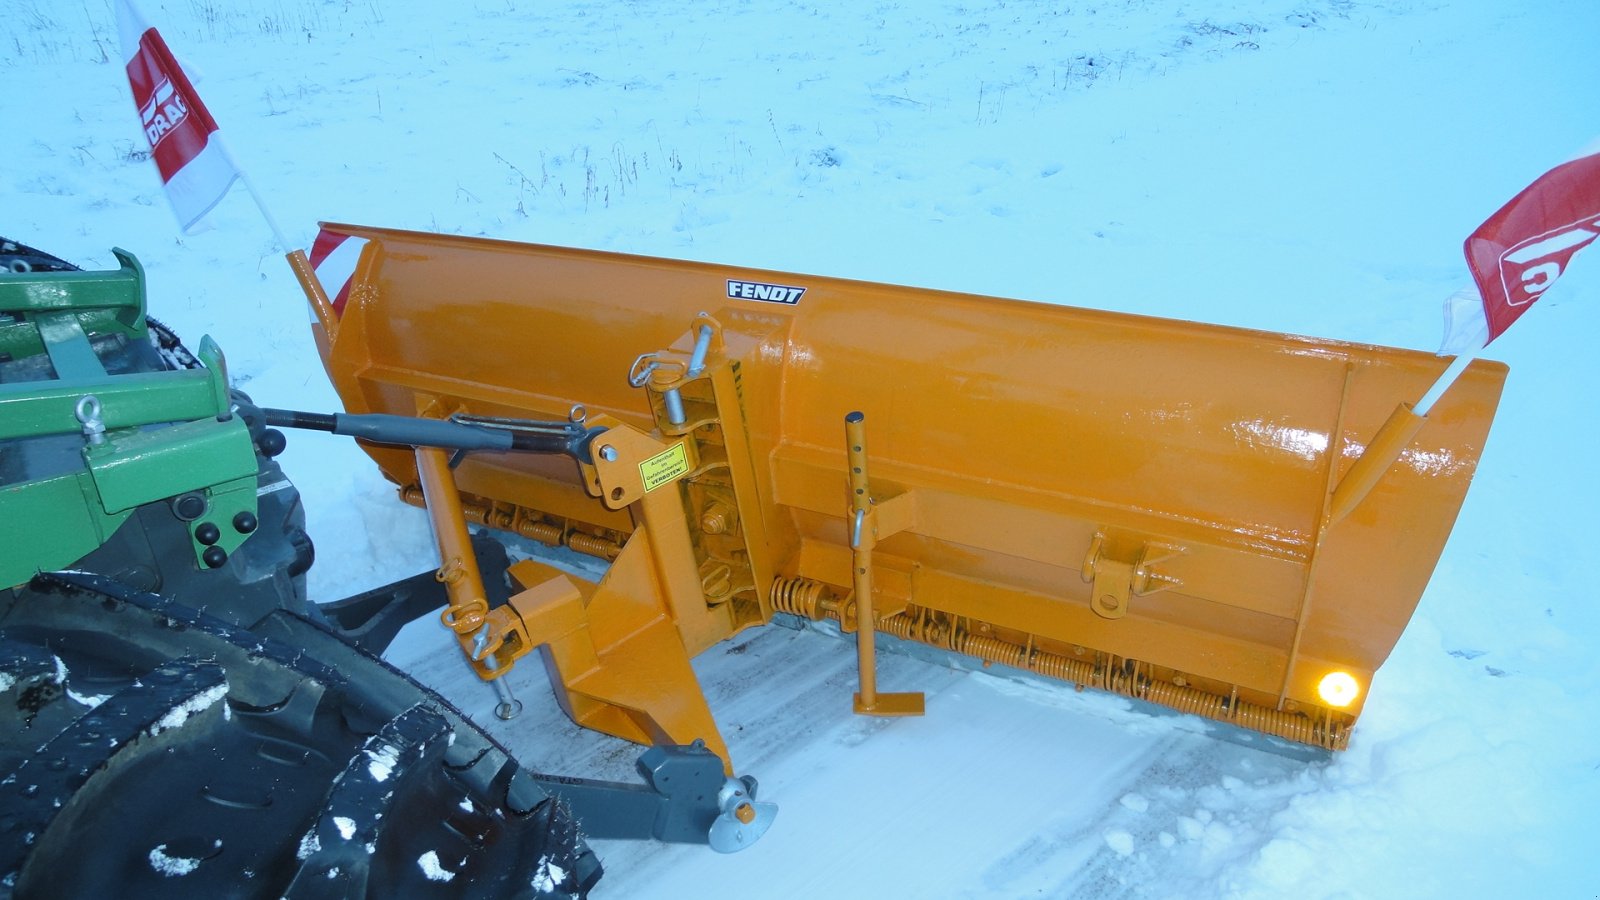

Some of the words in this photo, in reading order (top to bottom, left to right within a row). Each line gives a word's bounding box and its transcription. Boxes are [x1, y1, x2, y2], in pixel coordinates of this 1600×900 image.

[728, 281, 803, 303] FENDT
[651, 451, 675, 466] Aufenthalt
[646, 459, 684, 481] Gefahrenbereich
[651, 466, 682, 485] VERBOTEN!
